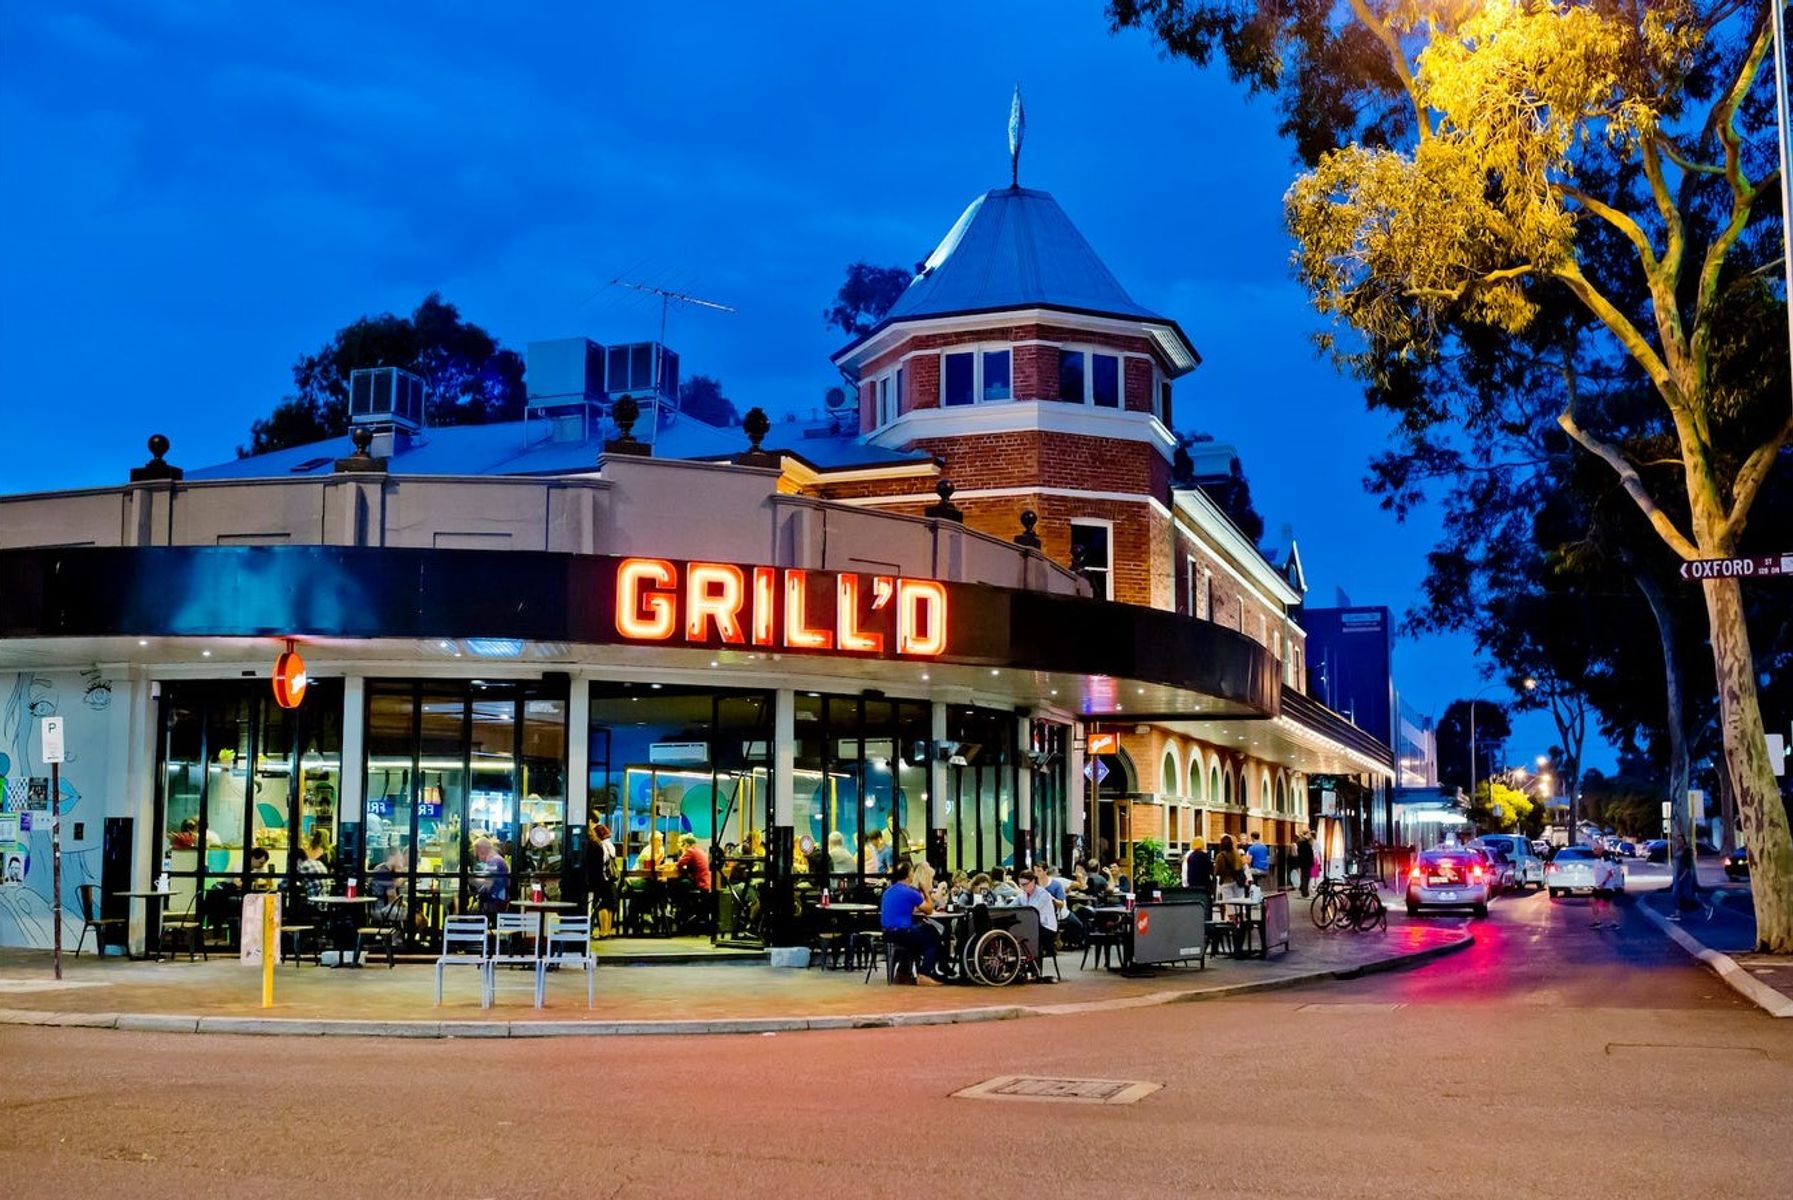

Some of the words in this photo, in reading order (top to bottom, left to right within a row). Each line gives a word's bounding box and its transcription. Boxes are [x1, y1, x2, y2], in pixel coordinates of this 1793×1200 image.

[1692, 559, 1754, 577] OXFORD
[1764, 557, 1772, 565] ST
[615, 557, 948, 656] GRILL'D
[48, 722, 57, 734] P
